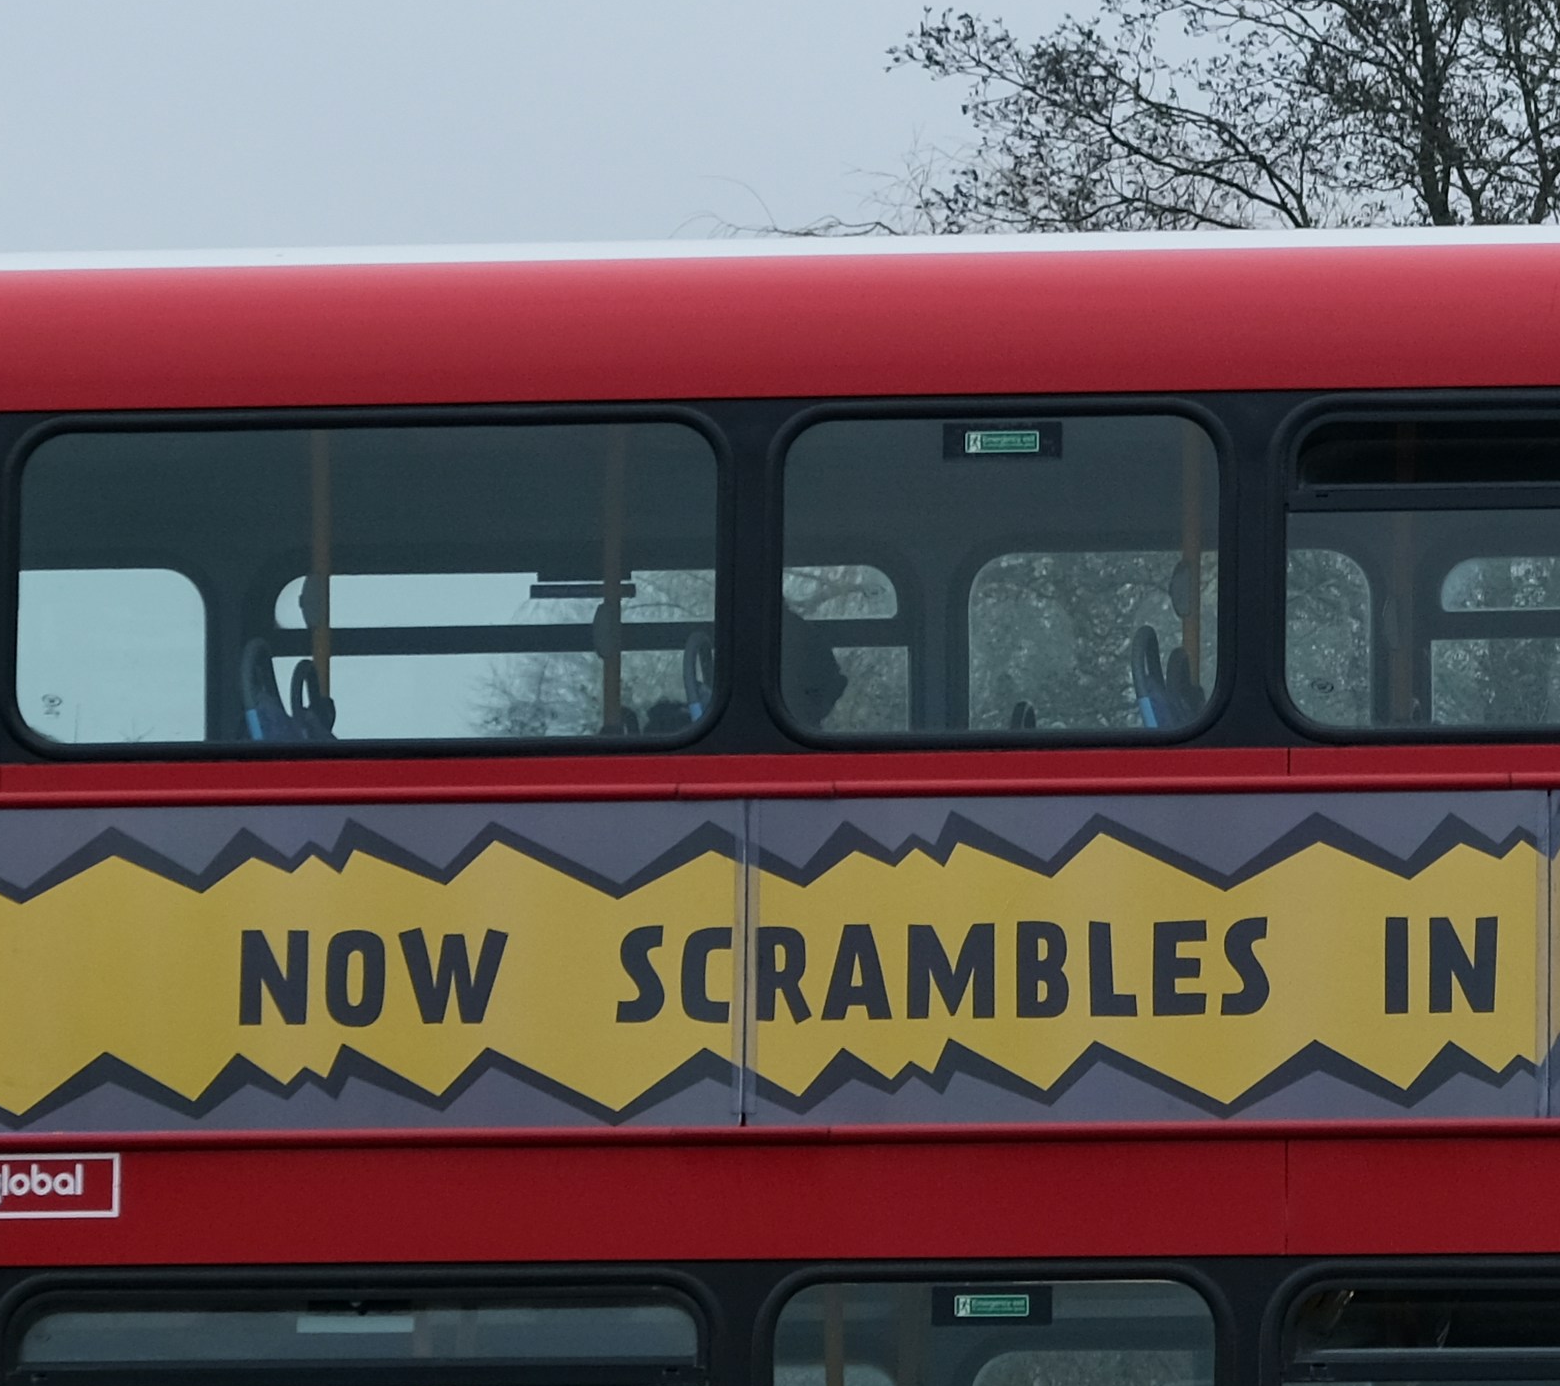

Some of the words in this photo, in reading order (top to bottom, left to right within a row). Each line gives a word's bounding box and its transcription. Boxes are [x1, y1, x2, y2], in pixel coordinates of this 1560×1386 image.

[238, 926, 510, 1026] NOW
[615, 916, 1272, 1025] SCRAMBLES
[1383, 915, 1500, 1015] IN
